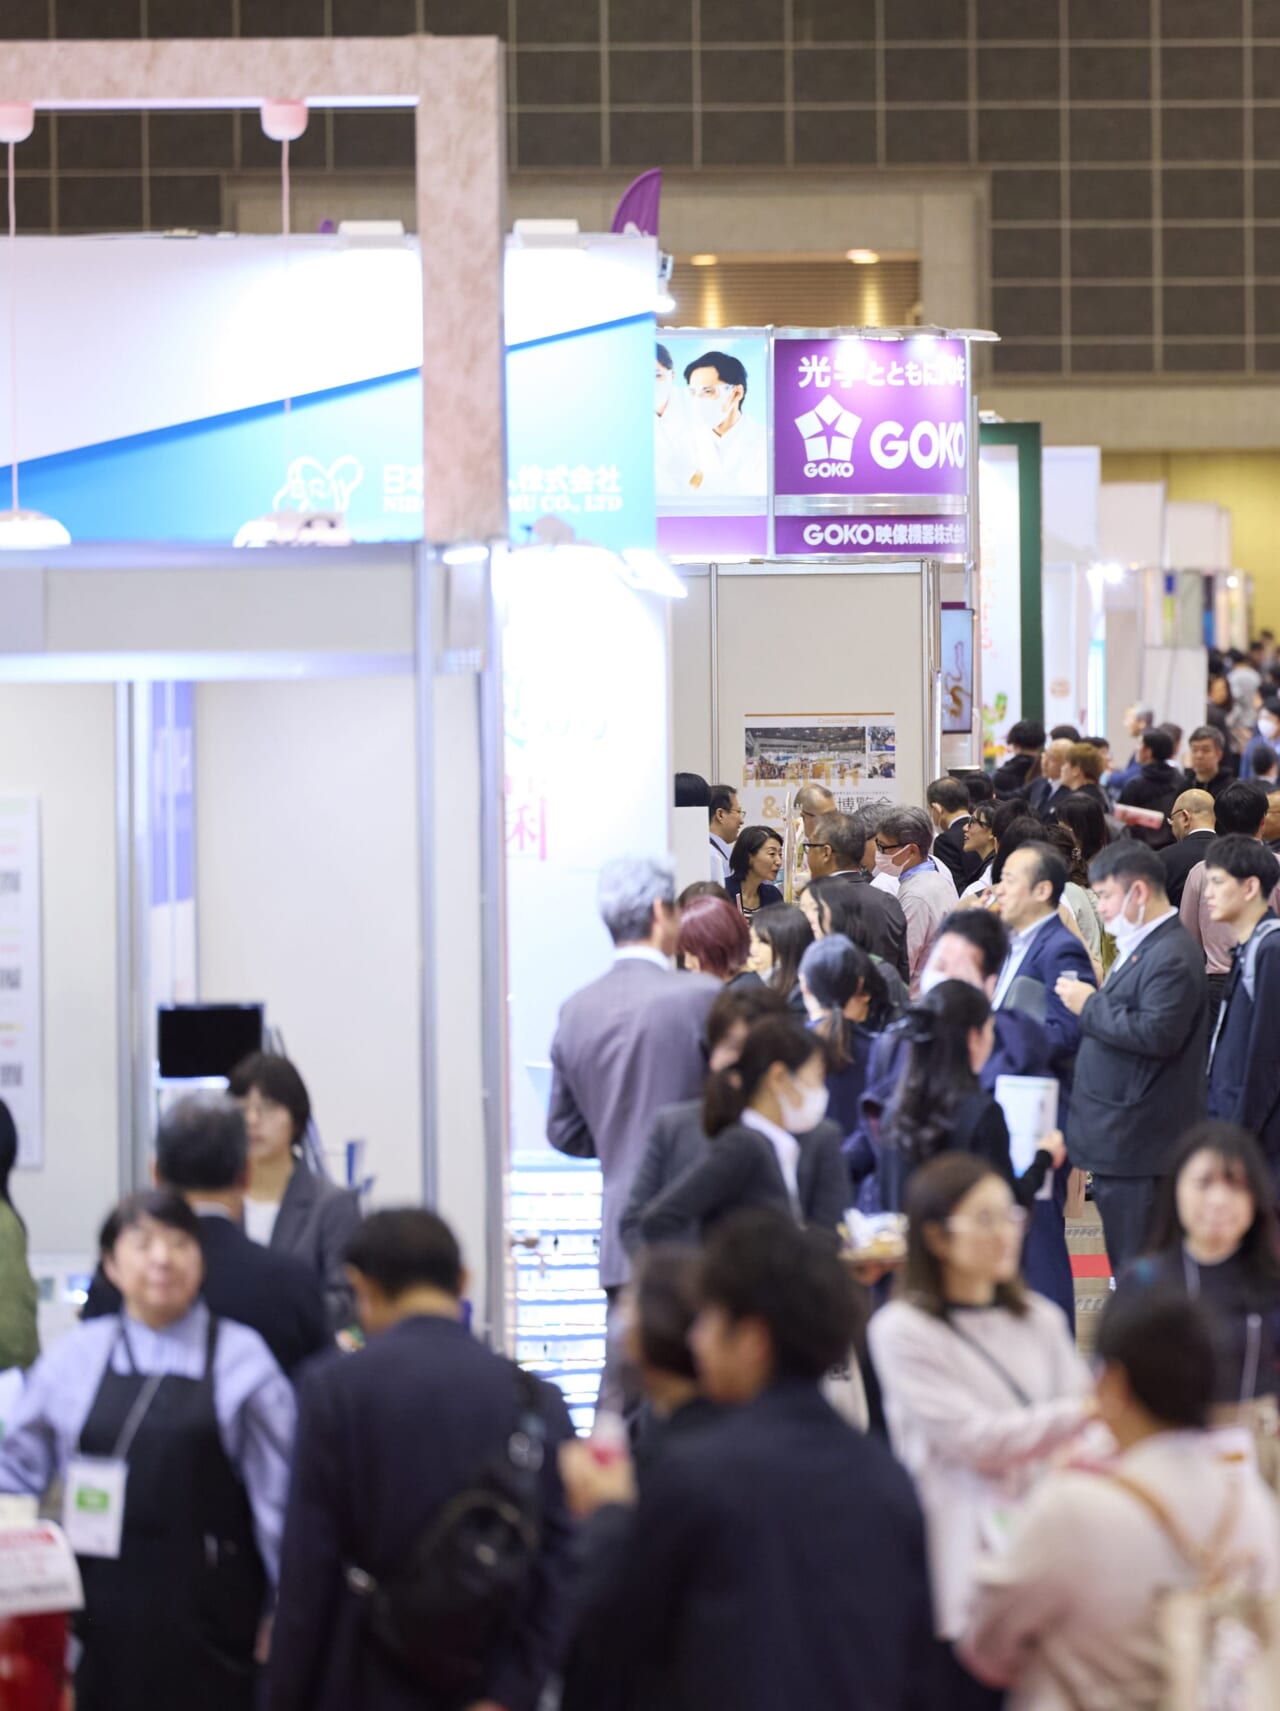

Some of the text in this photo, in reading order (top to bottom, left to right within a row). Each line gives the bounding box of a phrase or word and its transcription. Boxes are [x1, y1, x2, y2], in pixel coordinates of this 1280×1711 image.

[869, 421, 966, 469] GOKO
[803, 462, 854, 478] GOKO
[761, 795, 781, 819] &
